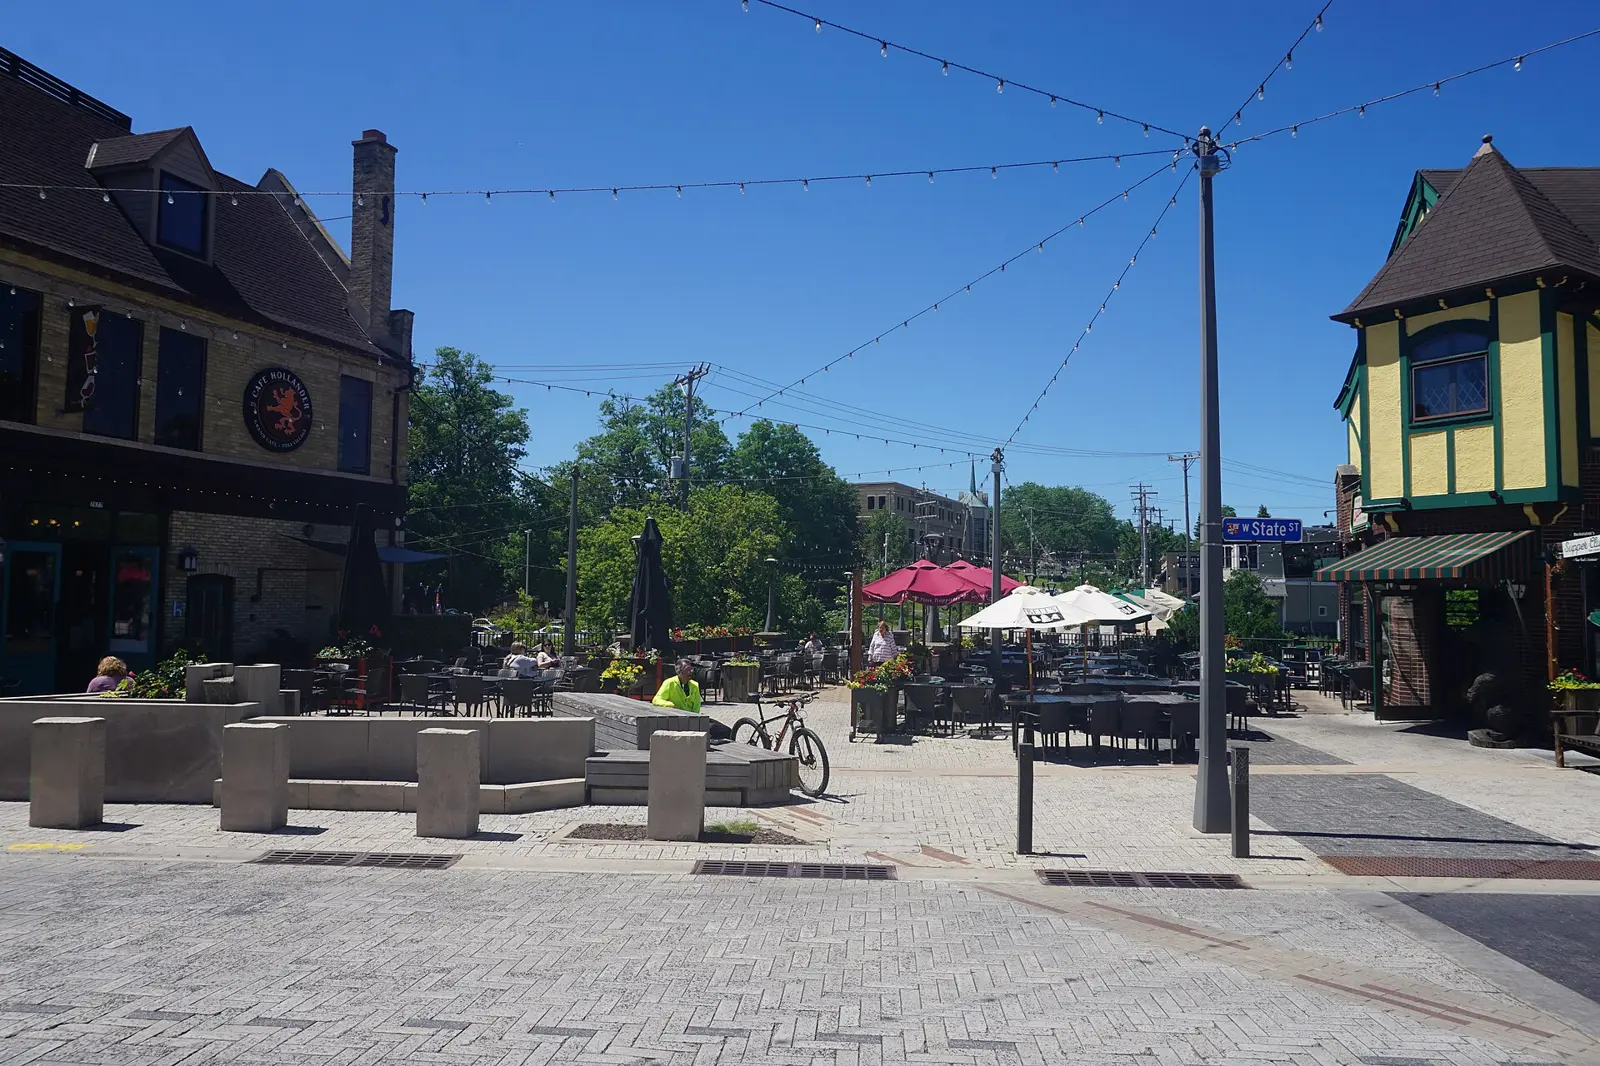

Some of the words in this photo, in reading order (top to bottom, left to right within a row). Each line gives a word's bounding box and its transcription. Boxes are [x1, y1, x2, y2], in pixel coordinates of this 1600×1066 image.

[252, 375, 268, 398] CAFE
[270, 371, 310, 409] HOLLANDER
[1242, 523, 1250, 533] W
[1251, 521, 1287, 537] State
[1288, 522, 1300, 532] ST
[1564, 541, 1588, 555] Supper
